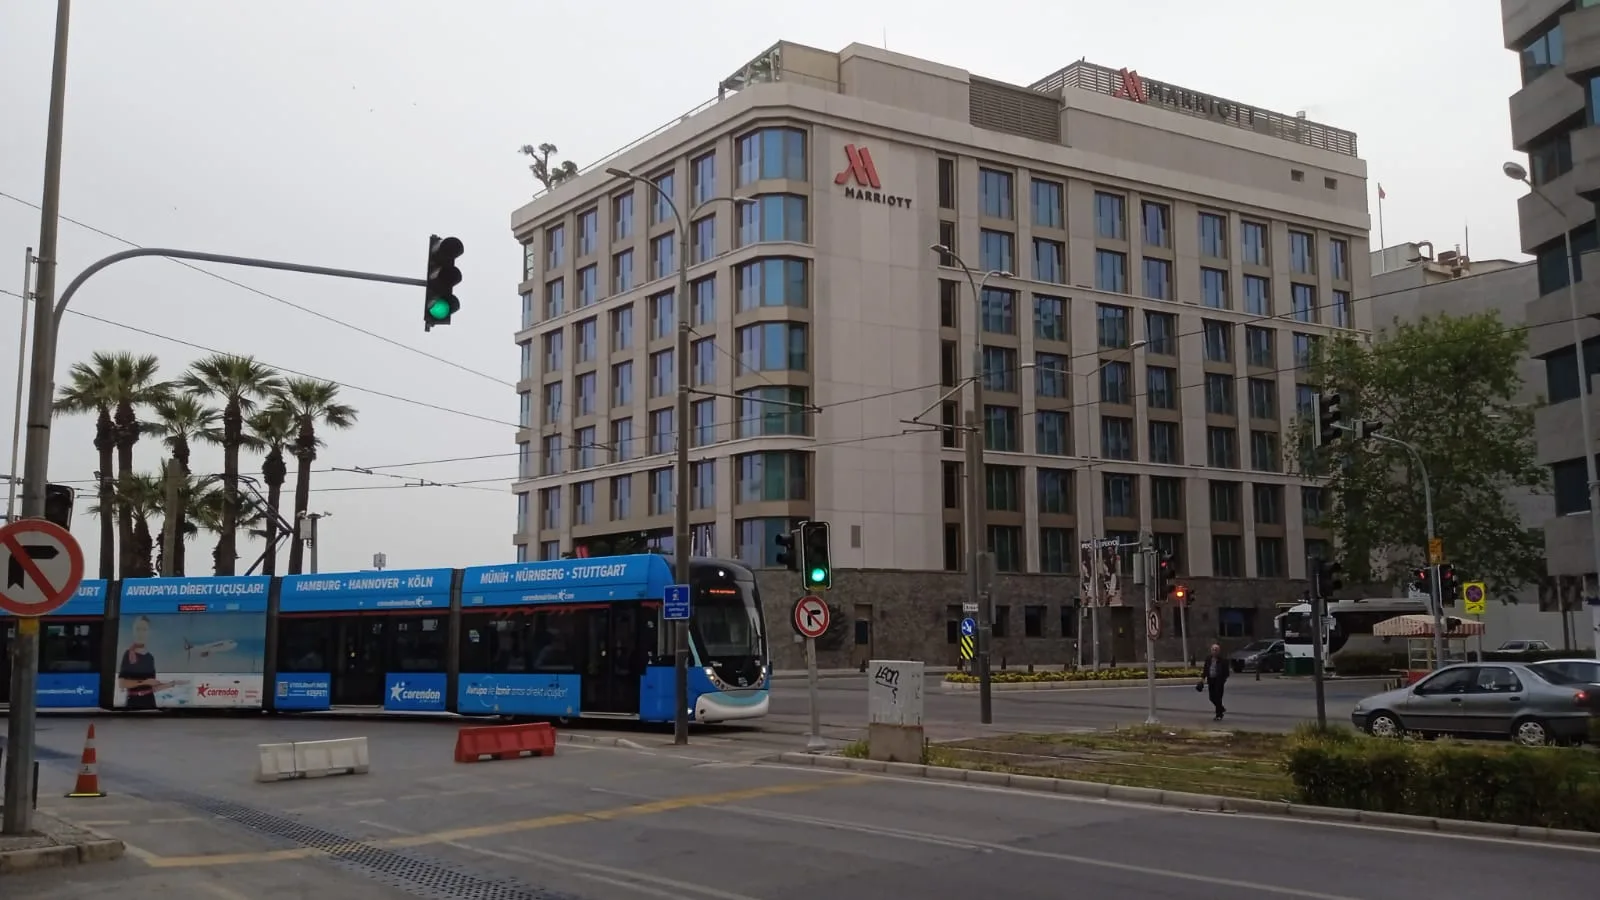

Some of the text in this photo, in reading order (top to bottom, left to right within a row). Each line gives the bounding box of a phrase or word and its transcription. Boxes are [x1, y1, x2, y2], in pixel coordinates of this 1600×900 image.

[845, 187, 912, 209] MARRIOTT
[515, 567, 564, 582] NÜRNBERG
[572, 563, 627, 579] STUTTGART
[126, 582, 264, 596] AVRUPA'YA DİREKT UÇUŞLAR!
[296, 574, 434, 591] HAMBURG HANNOVER KÖLN
